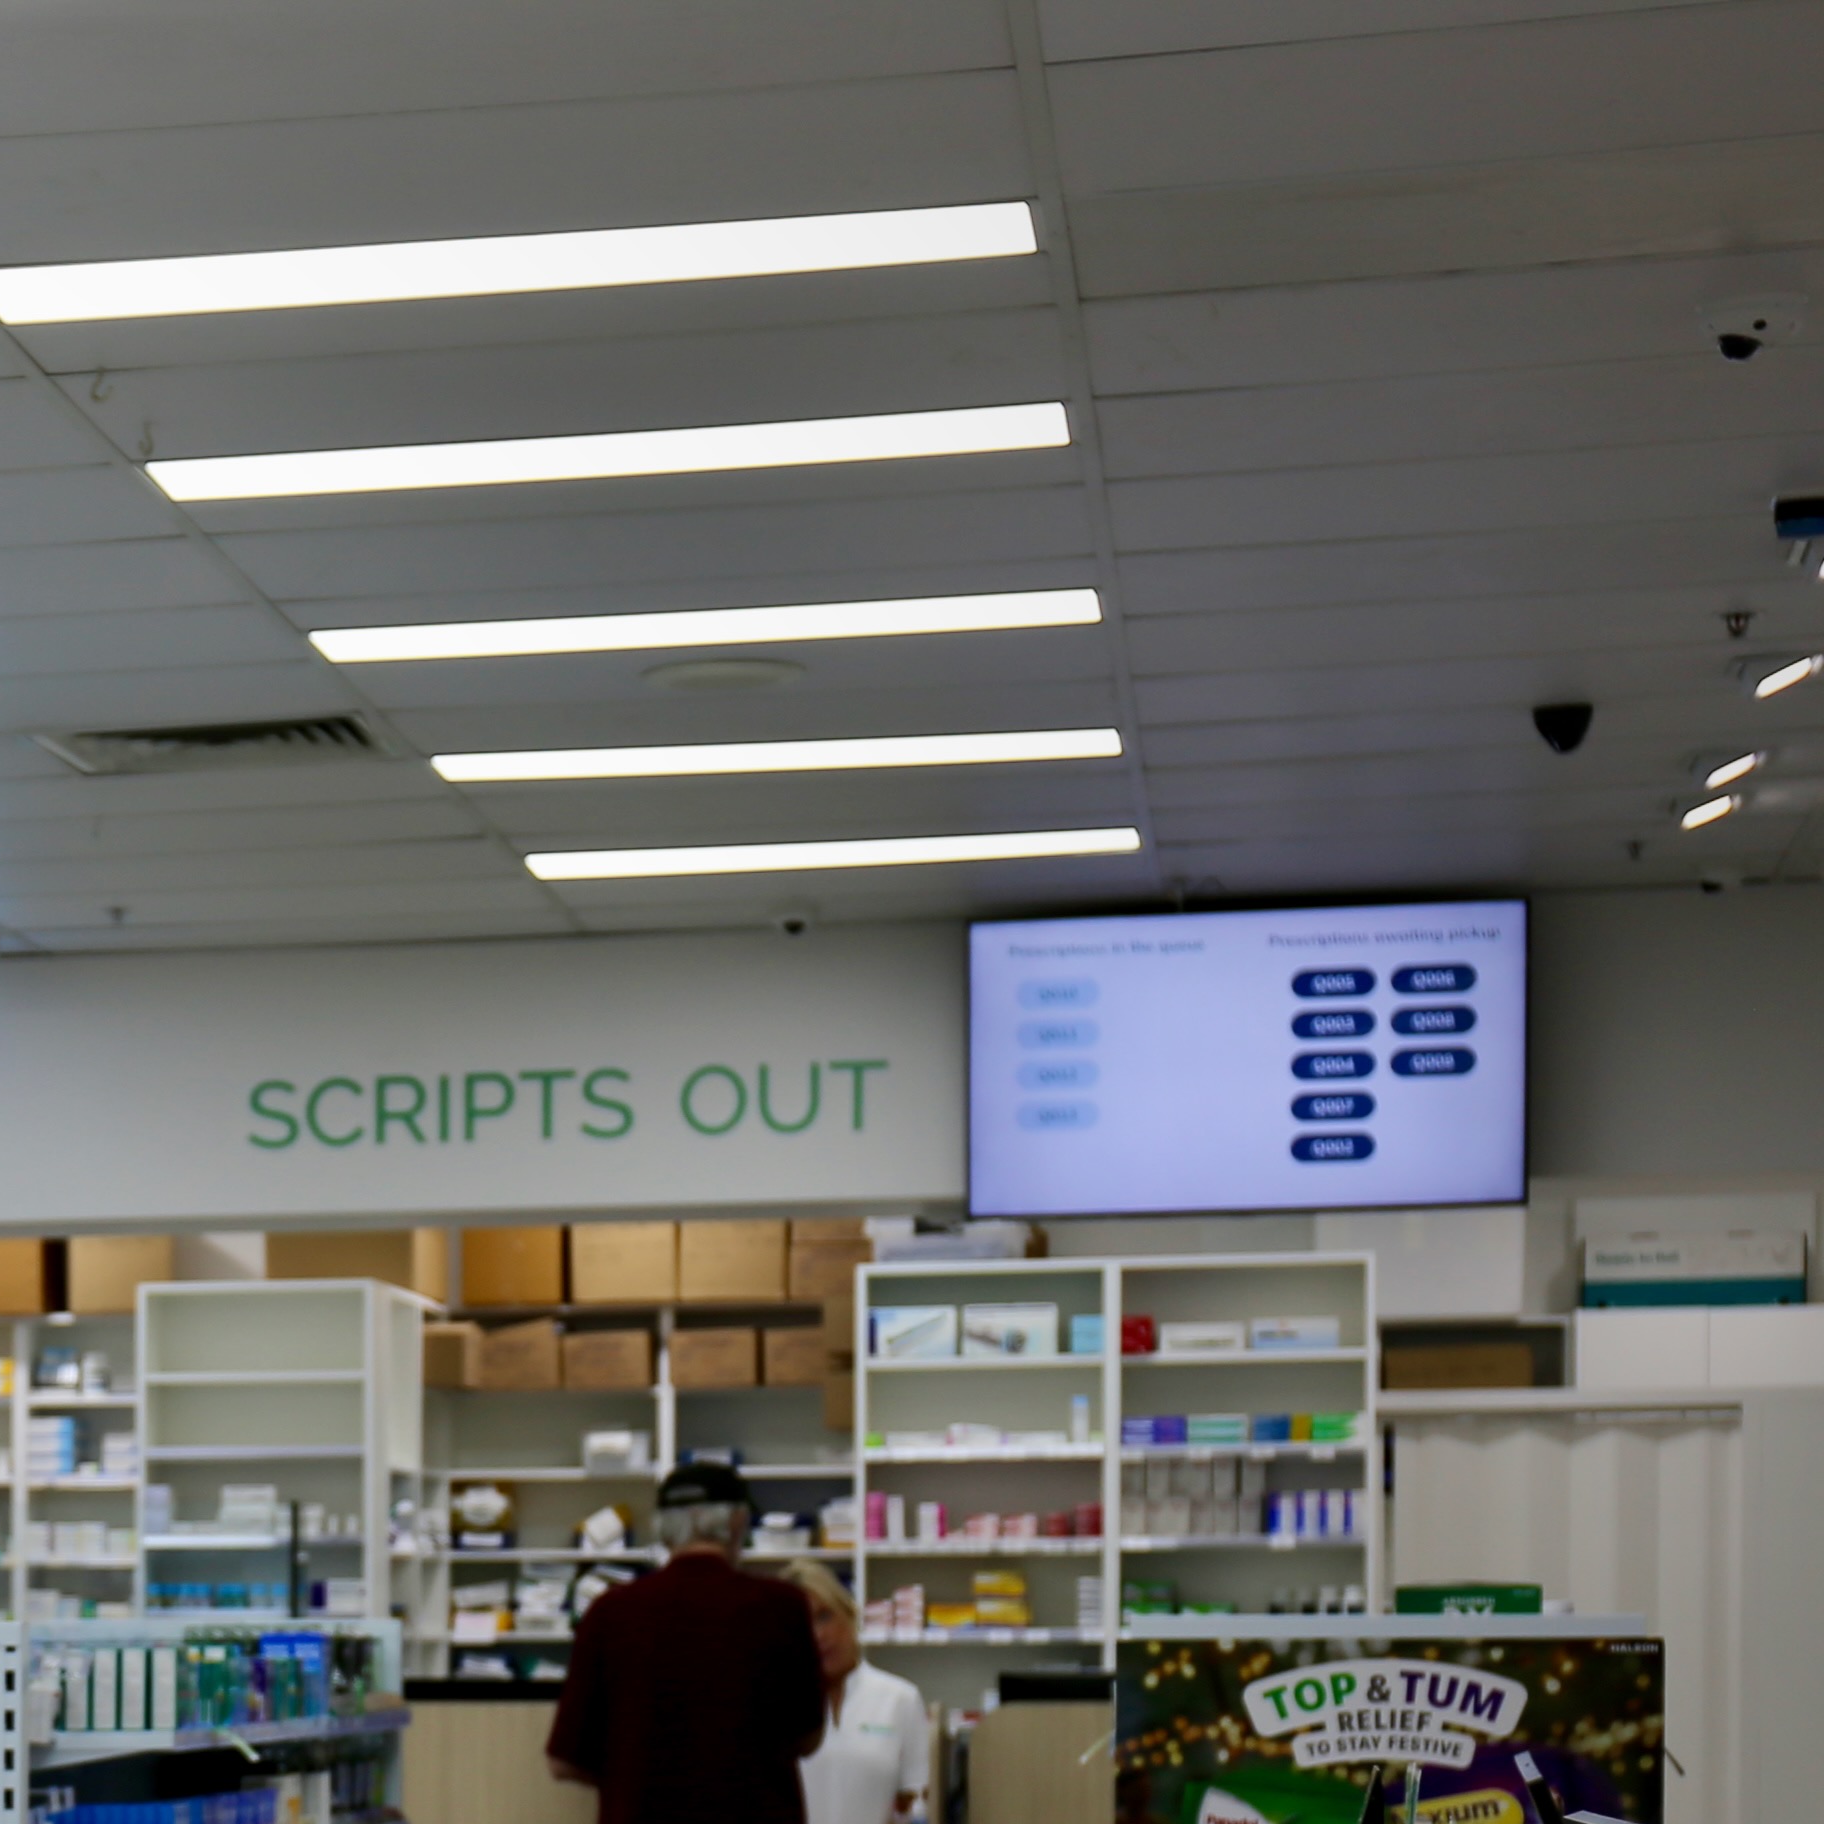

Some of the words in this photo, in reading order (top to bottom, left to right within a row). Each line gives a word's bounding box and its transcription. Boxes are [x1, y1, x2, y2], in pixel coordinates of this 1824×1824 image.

[246, 1066, 637, 1152] SCRIPTS
[680, 1056, 890, 1135] OUT
[1263, 1671, 1357, 1722] TOP
[1366, 1674, 1392, 1703] &
[1399, 1669, 1506, 1724] TUM
[1337, 1710, 1433, 1732] RELIEF
[1306, 1740, 1331, 1757] TO
[1336, 1736, 1382, 1753] STAY
[1388, 1735, 1463, 1758] FESTIVE
